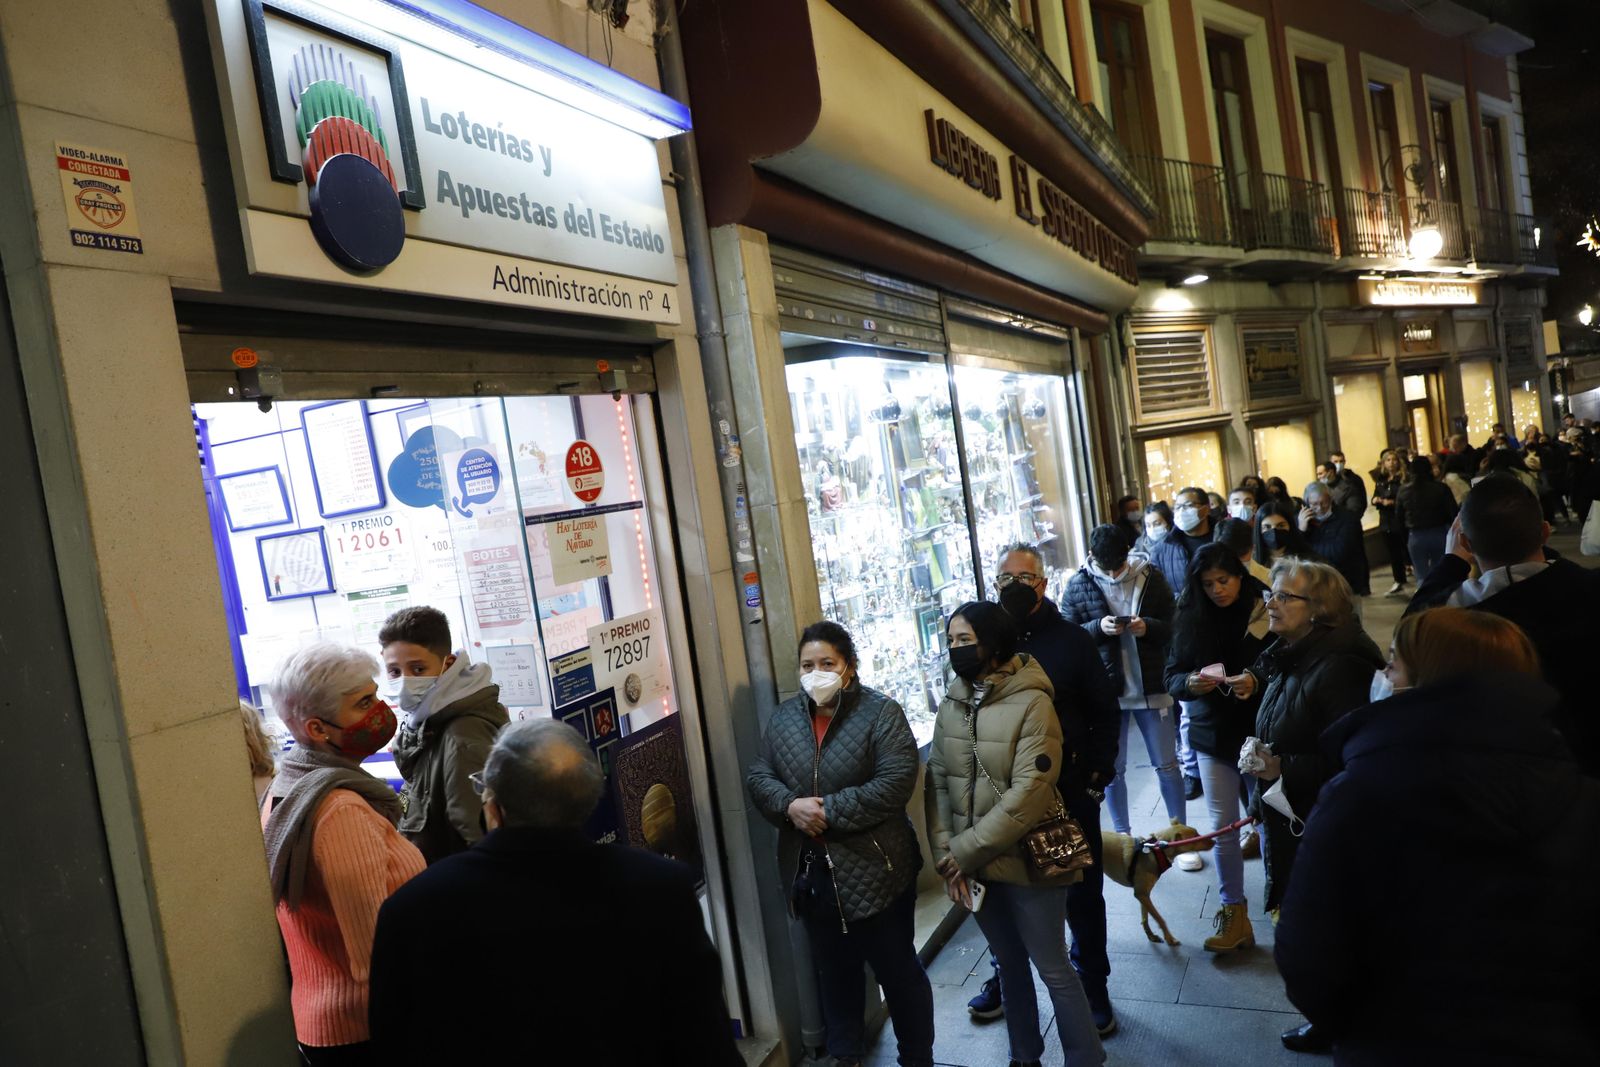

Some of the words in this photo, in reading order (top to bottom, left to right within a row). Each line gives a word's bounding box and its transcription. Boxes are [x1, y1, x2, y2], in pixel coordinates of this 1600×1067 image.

[420, 97, 534, 163] Loterías
[539, 144, 552, 177] y
[59, 146, 124, 167] VIDEO-ALARMA
[68, 161, 121, 179] CONECTADA
[1009, 155, 1041, 227] EL
[437, 169, 557, 229] Apuestas
[564, 203, 596, 239] del
[599, 213, 665, 254] Estado
[74, 233, 95, 246] 902
[98, 236, 118, 249] 114
[120, 239, 139, 251] 573
[492, 265, 633, 310] Administración
[639, 290, 654, 311] nº
[662, 293, 671, 314] 4
[465, 457, 486, 465] CENTRO
[571, 447, 593, 467] +18
[351, 515, 393, 532] PREMIO
[556, 522, 572, 535] HAY
[572, 519, 598, 532] LOTERÍA
[337, 528, 403, 554] 12061
[574, 532, 582, 540] DE
[472, 547, 511, 561] BOTES
[566, 539, 594, 554] NAVIDAD
[611, 618, 651, 641] PREMIO
[604, 636, 651, 673] 72897
